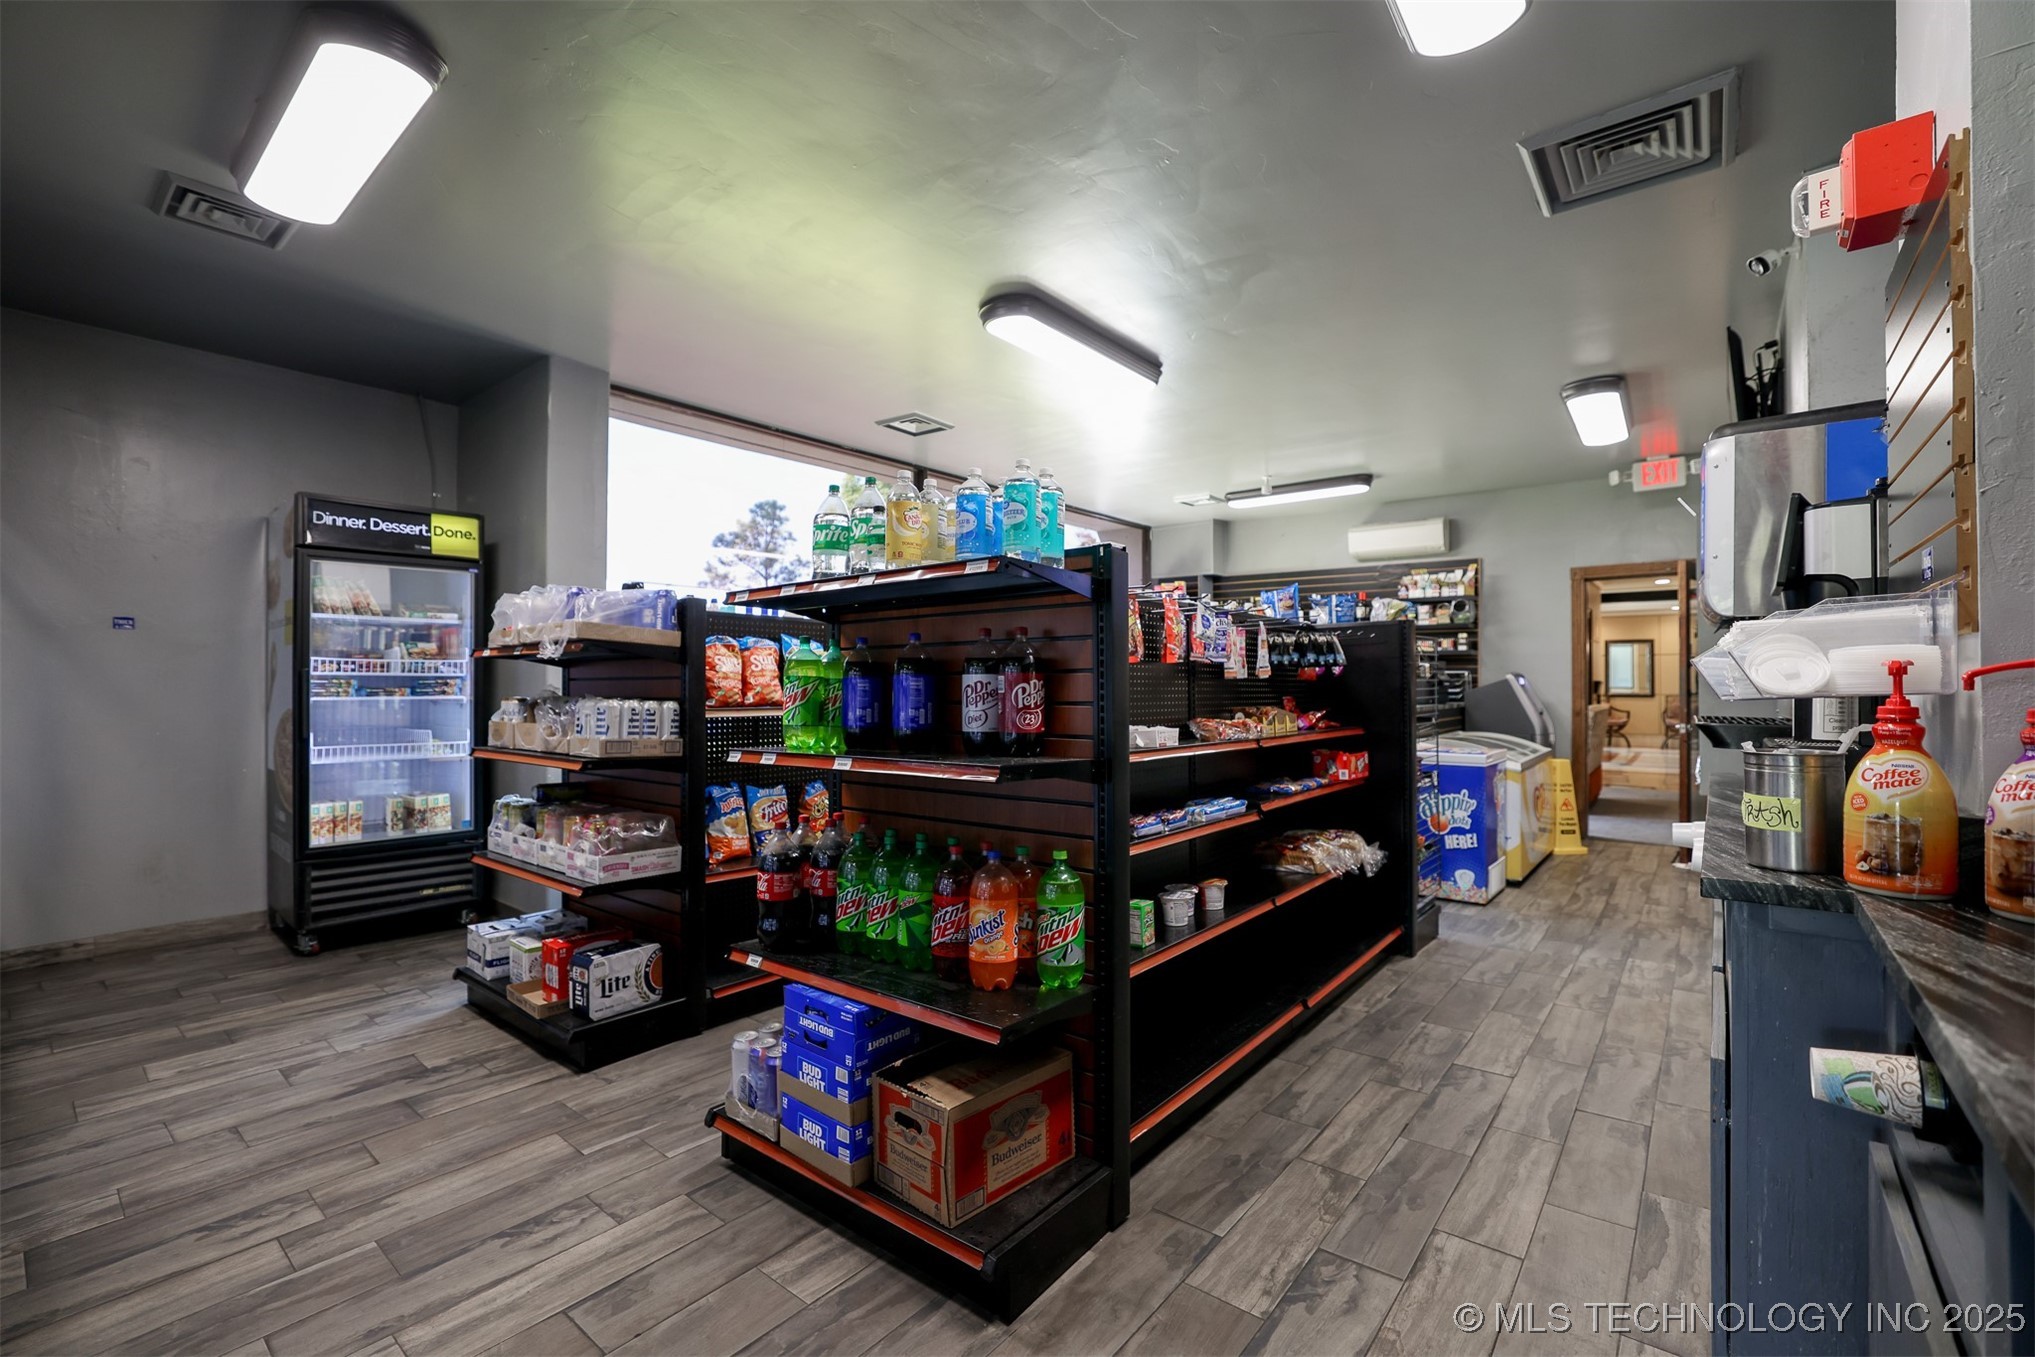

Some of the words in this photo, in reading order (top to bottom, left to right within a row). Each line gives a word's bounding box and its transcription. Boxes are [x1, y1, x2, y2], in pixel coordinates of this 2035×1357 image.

[1819, 178, 1831, 219] FIRE
[1641, 458, 1680, 487] EXIT
[312, 510, 367, 530] Dinner.
[369, 517, 432, 537] Dessert.
[433, 525, 477, 541] Done.
[813, 525, 849, 546] prite
[974, 680, 992, 694] Dr
[1030, 679, 1045, 695] Dr
[967, 713, 983, 724] Diet
[1024, 713, 1036, 725] 23
[1861, 768, 1921, 782] Coffee
[1873, 777, 1922, 791] mate
[761, 799, 788, 823] Frito
[1449, 813, 1472, 830] dots
[1444, 833, 1478, 850] HERE!
[600, 976, 631, 999] Lite
[799, 1015, 819, 1033] LIGHT
[818, 1024, 834, 1039] BUD
[893, 1026, 912, 1041] BUD
[866, 1035, 894, 1052] LIGHT
[802, 1061, 822, 1080] BUD
[799, 1070, 826, 1093] LIGHT
[802, 1117, 823, 1137] BUD
[799, 1127, 827, 1152] LIGHT
[889, 1142, 929, 1174] Budweiser
[991, 1131, 1043, 1167] Budweiser
